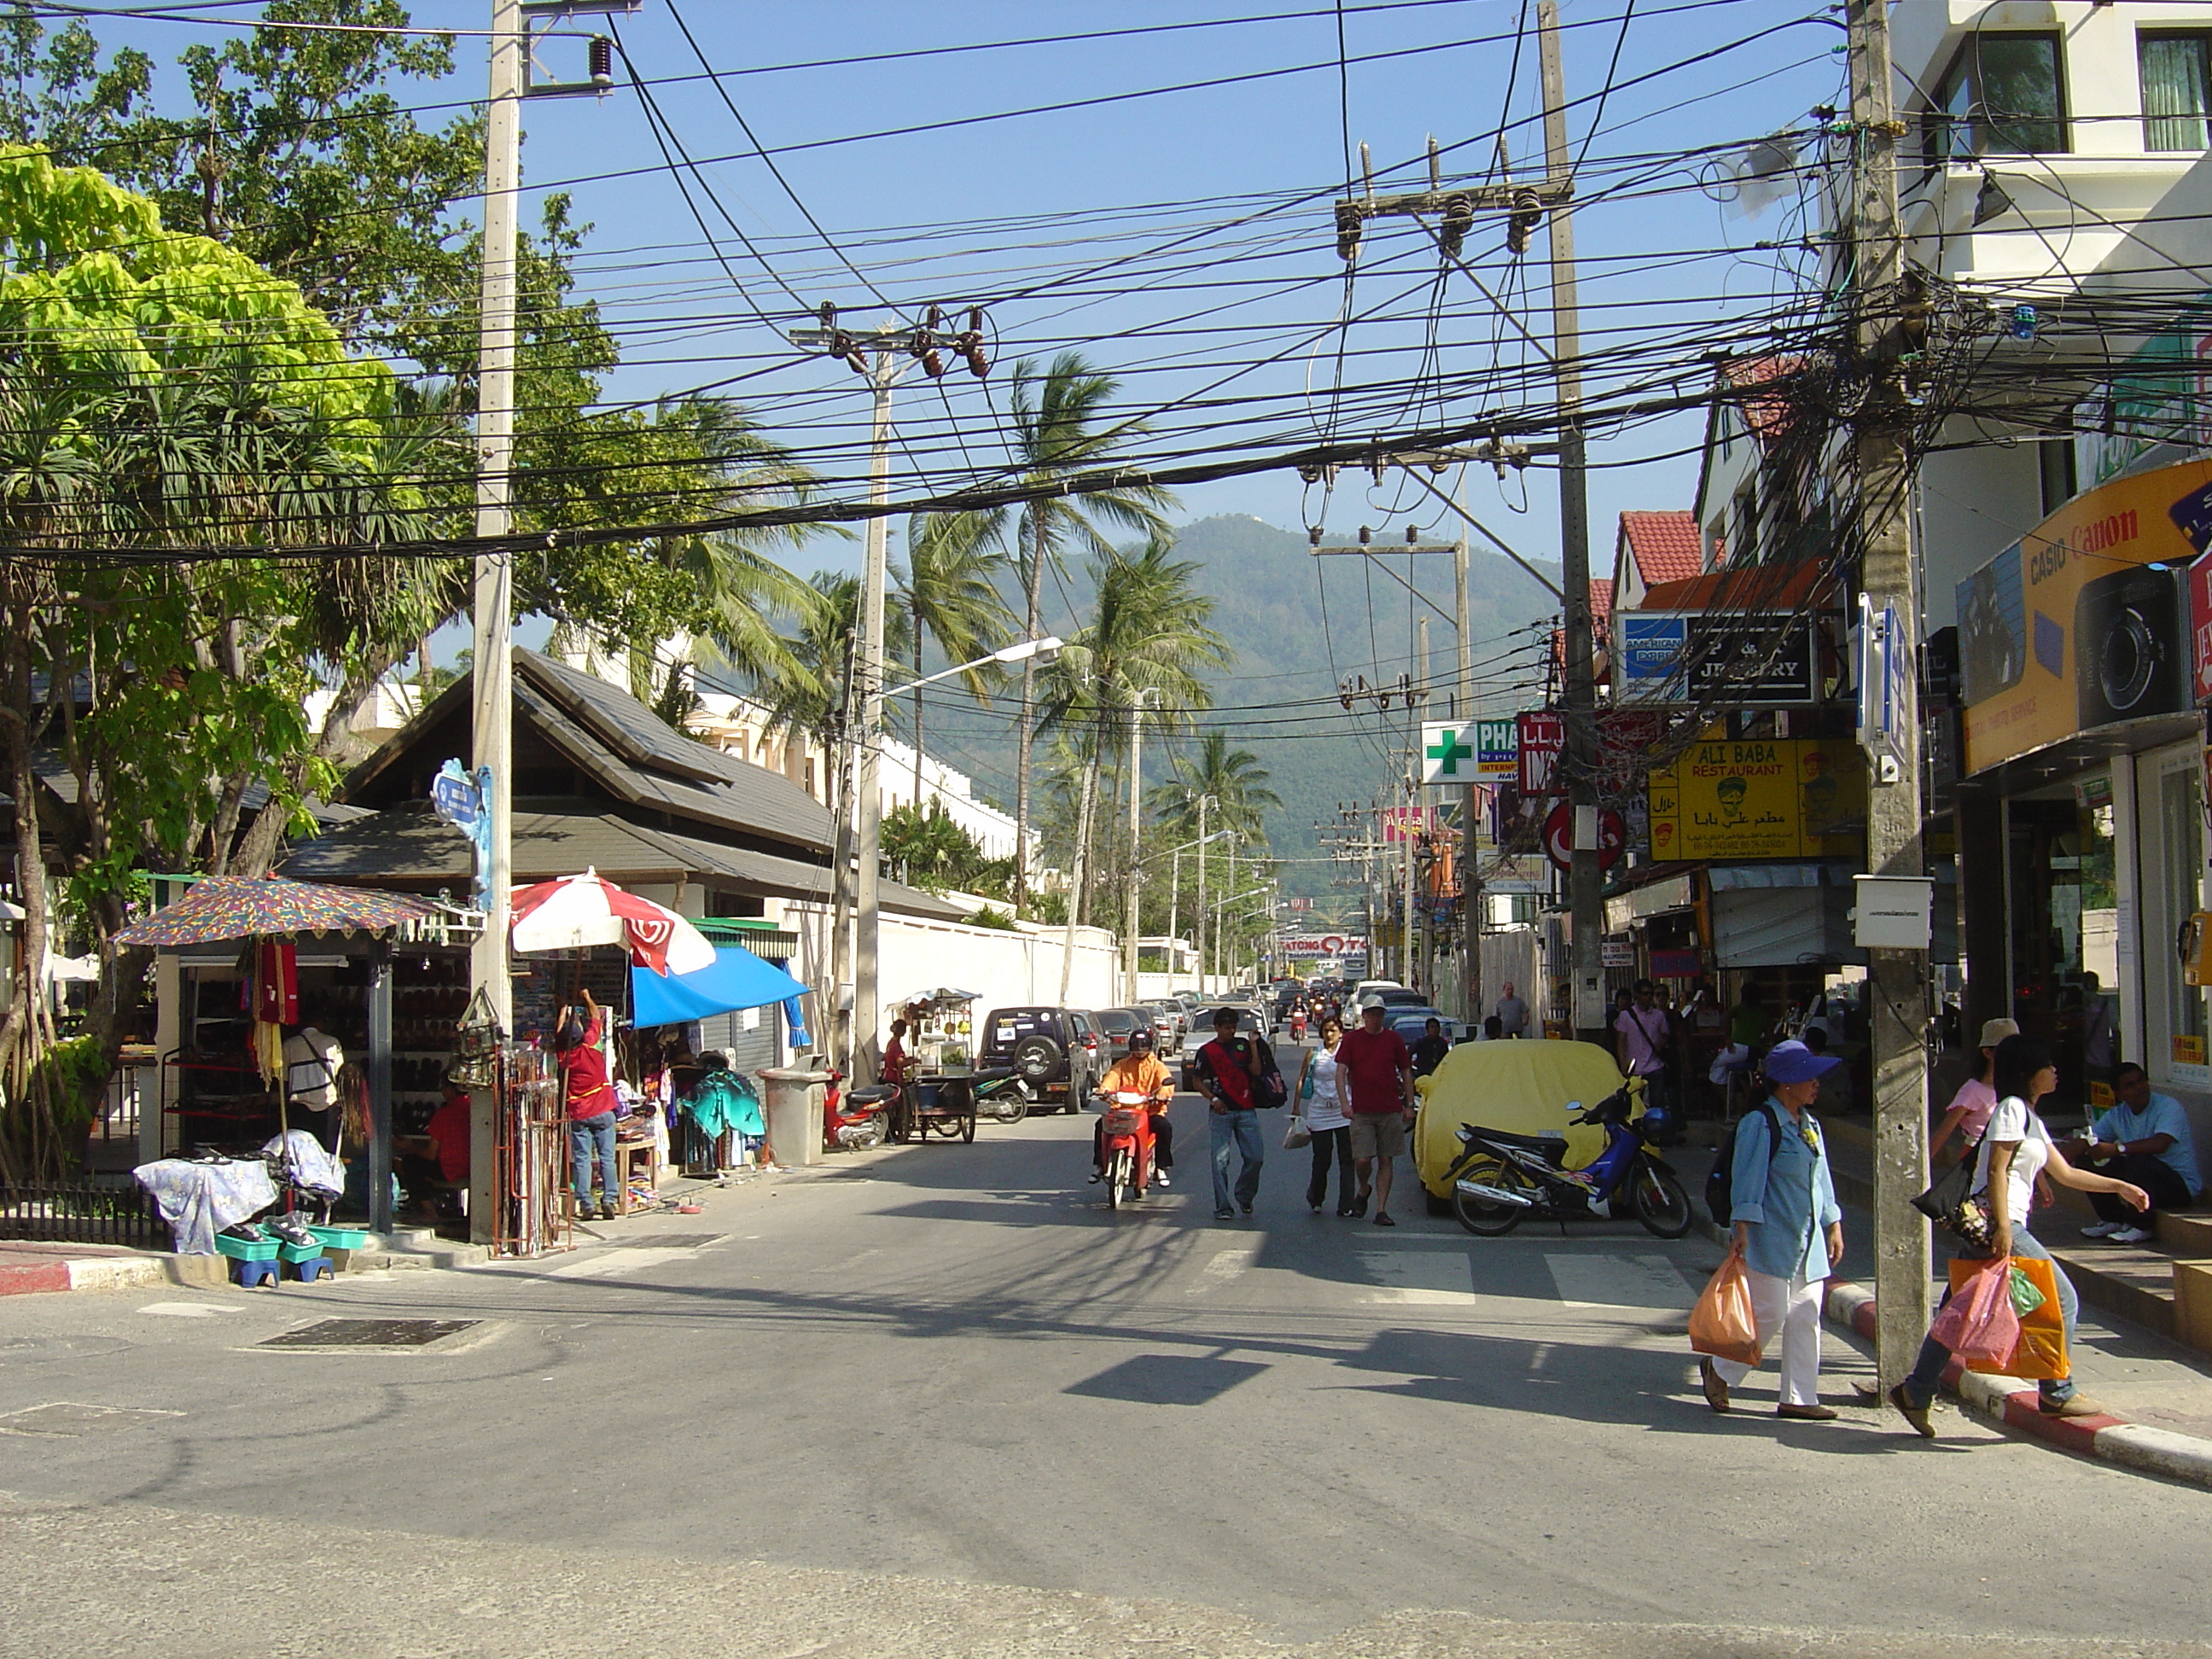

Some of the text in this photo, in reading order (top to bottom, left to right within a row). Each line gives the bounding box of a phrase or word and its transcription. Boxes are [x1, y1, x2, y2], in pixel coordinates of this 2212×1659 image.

[2030, 509, 2139, 585] CASIO Canon
[1626, 638, 1682, 649] AMERICAN
[1741, 642, 1757, 655] &
[2197, 622, 2212, 673] JE
[1636, 650, 1679, 661] EXPRE
[1700, 661, 1798, 677] JERY
[1699, 744, 1776, 764] ALI BABA
[1692, 764, 1784, 777] RESTAURANT
[1281, 940, 1319, 951] ATONG
